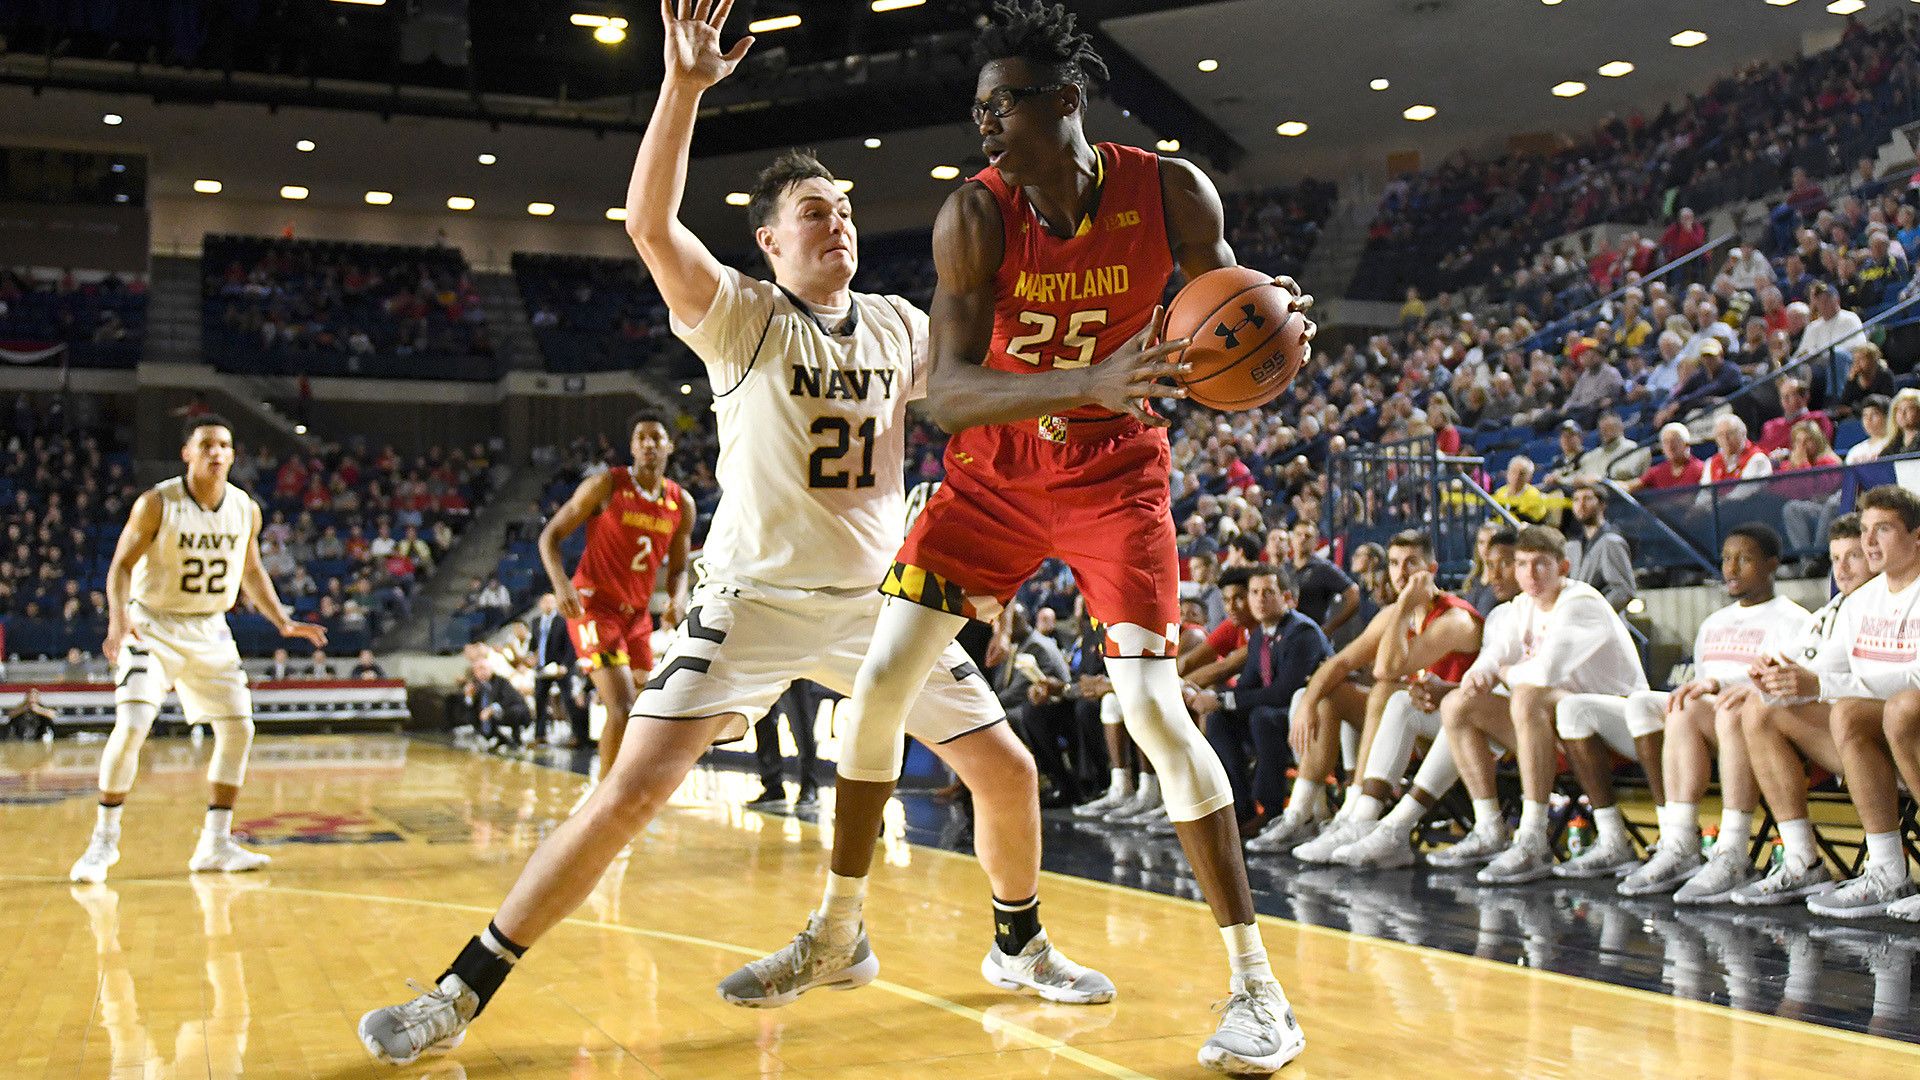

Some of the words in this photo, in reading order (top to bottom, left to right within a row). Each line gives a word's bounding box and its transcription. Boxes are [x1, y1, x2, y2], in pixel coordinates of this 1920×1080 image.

[1013, 264, 1130, 303] MARYLAND
[1006, 309, 1108, 370] 25
[790, 364, 894, 400] NAVY
[1250, 349, 1285, 385] 695
[808, 415, 876, 488] 21
[179, 532, 239, 550] NAVY
[630, 535, 652, 572] 2
[181, 557, 228, 594] 22
[578, 620, 599, 650] M
